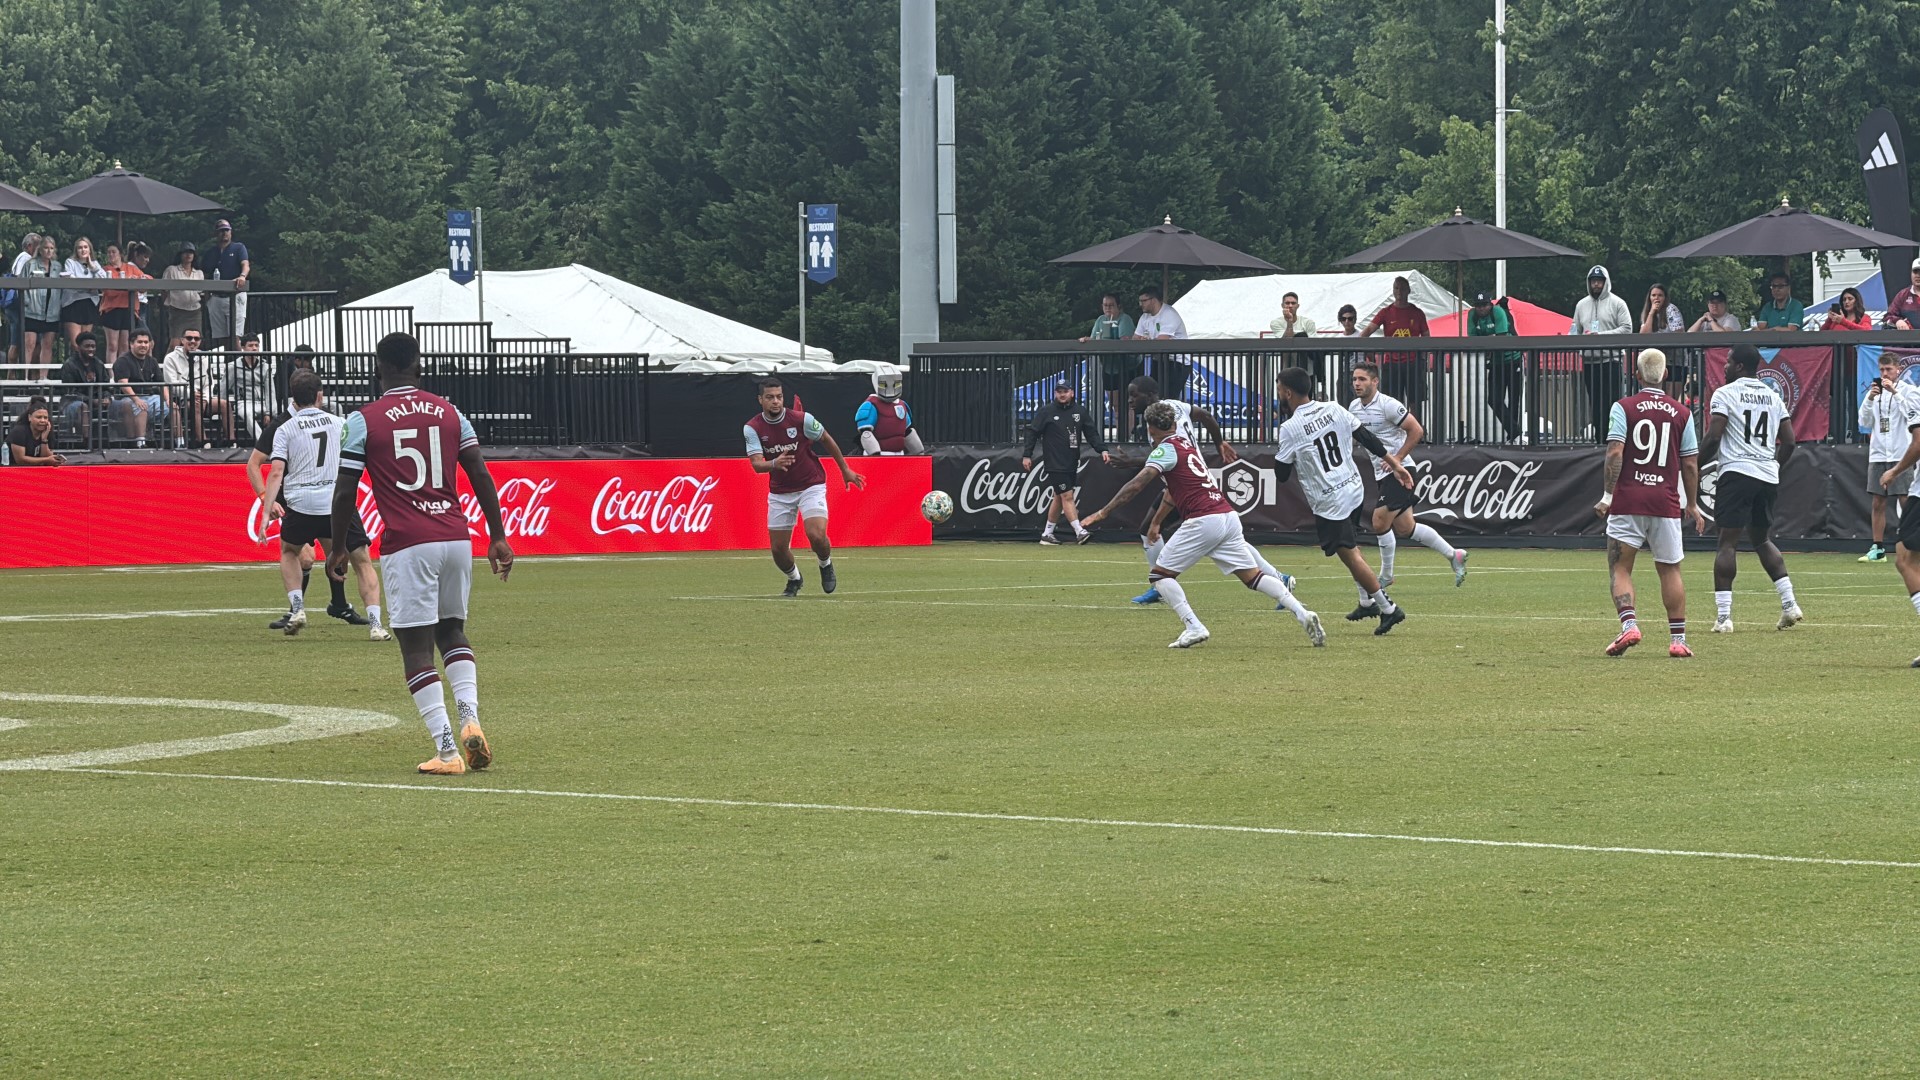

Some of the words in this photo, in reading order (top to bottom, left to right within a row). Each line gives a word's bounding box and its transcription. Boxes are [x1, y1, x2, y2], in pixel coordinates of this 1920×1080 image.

[448, 228, 471, 237] RESTROOM
[808, 223, 834, 232] RESTROOM
[1636, 400, 1678, 418] STINSON
[1740, 392, 1773, 406] ASSAMOI
[385, 400, 445, 422] PALMER
[297, 416, 333, 430] CANTOR
[1303, 413, 1335, 436] BELTRAN
[1742, 409, 1769, 448] 14
[311, 430, 328, 468] 7
[763, 440, 799, 455] betway
[1313, 430, 1344, 473] 18
[1632, 418, 1671, 467] 91
[392, 425, 443, 491] 51
[960, 458, 1090, 515] Coca-Co
[1634, 470, 1657, 482] Lyca
[590, 475, 720, 535] Coca-Cola
